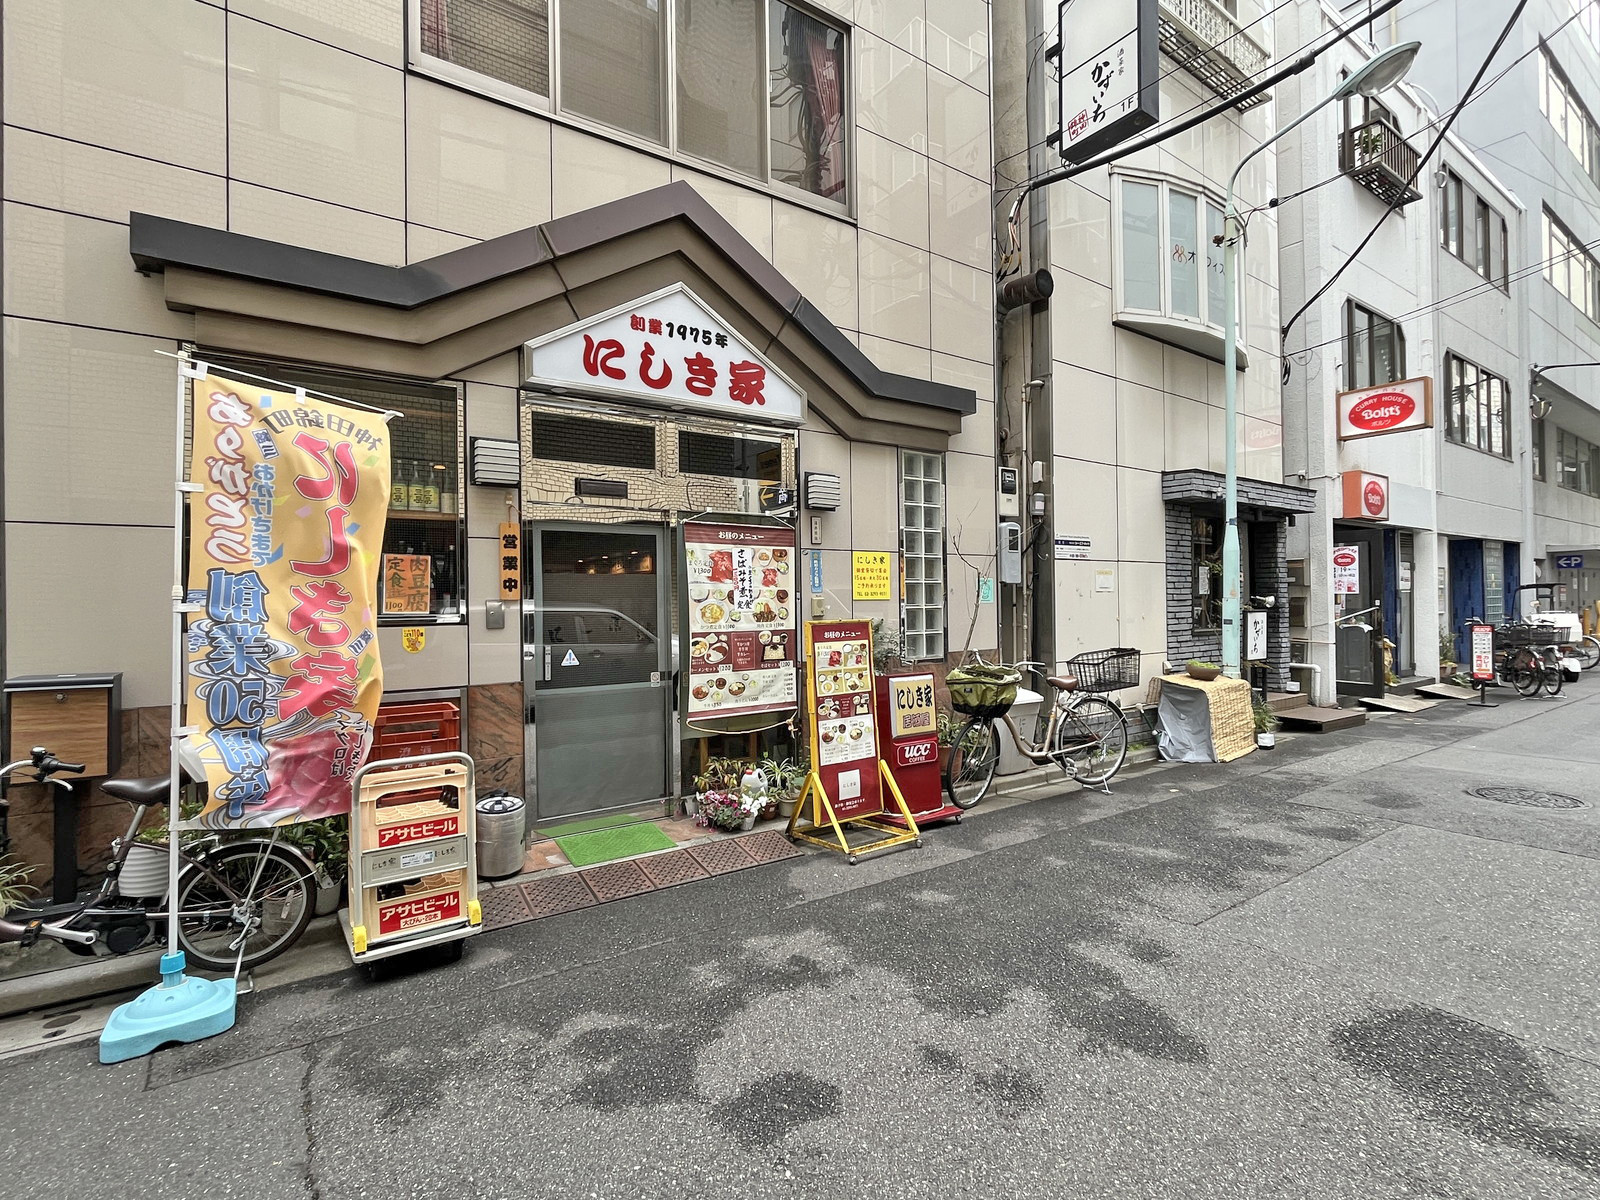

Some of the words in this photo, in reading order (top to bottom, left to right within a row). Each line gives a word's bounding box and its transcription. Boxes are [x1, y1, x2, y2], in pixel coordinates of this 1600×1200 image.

[1091, 61, 1115, 123] かずいち
[1121, 96, 1134, 112] 1F
[630, 313, 729, 349] 創業1975年
[582, 333, 767, 407] にしき家
[1355, 397, 1378, 412] CURRY
[1381, 395, 1408, 405] HOUSE
[1361, 405, 1401, 420] Bolst's
[718, 531, 764, 540] お昼のメニュー
[502, 534, 518, 592] 営業中
[857, 556, 886, 565] にしき家
[1571, 557, 1581, 567] P
[404, 555, 429, 612] 肉豆腐
[823, 631, 861, 639] お昼のメニュー
[896, 683, 933, 710] にしき家
[902, 711, 931, 730] 居酒屋
[904, 743, 931, 759] UCC
[381, 819, 457, 844] アサヒビール
[381, 895, 458, 922] アサヒビール
